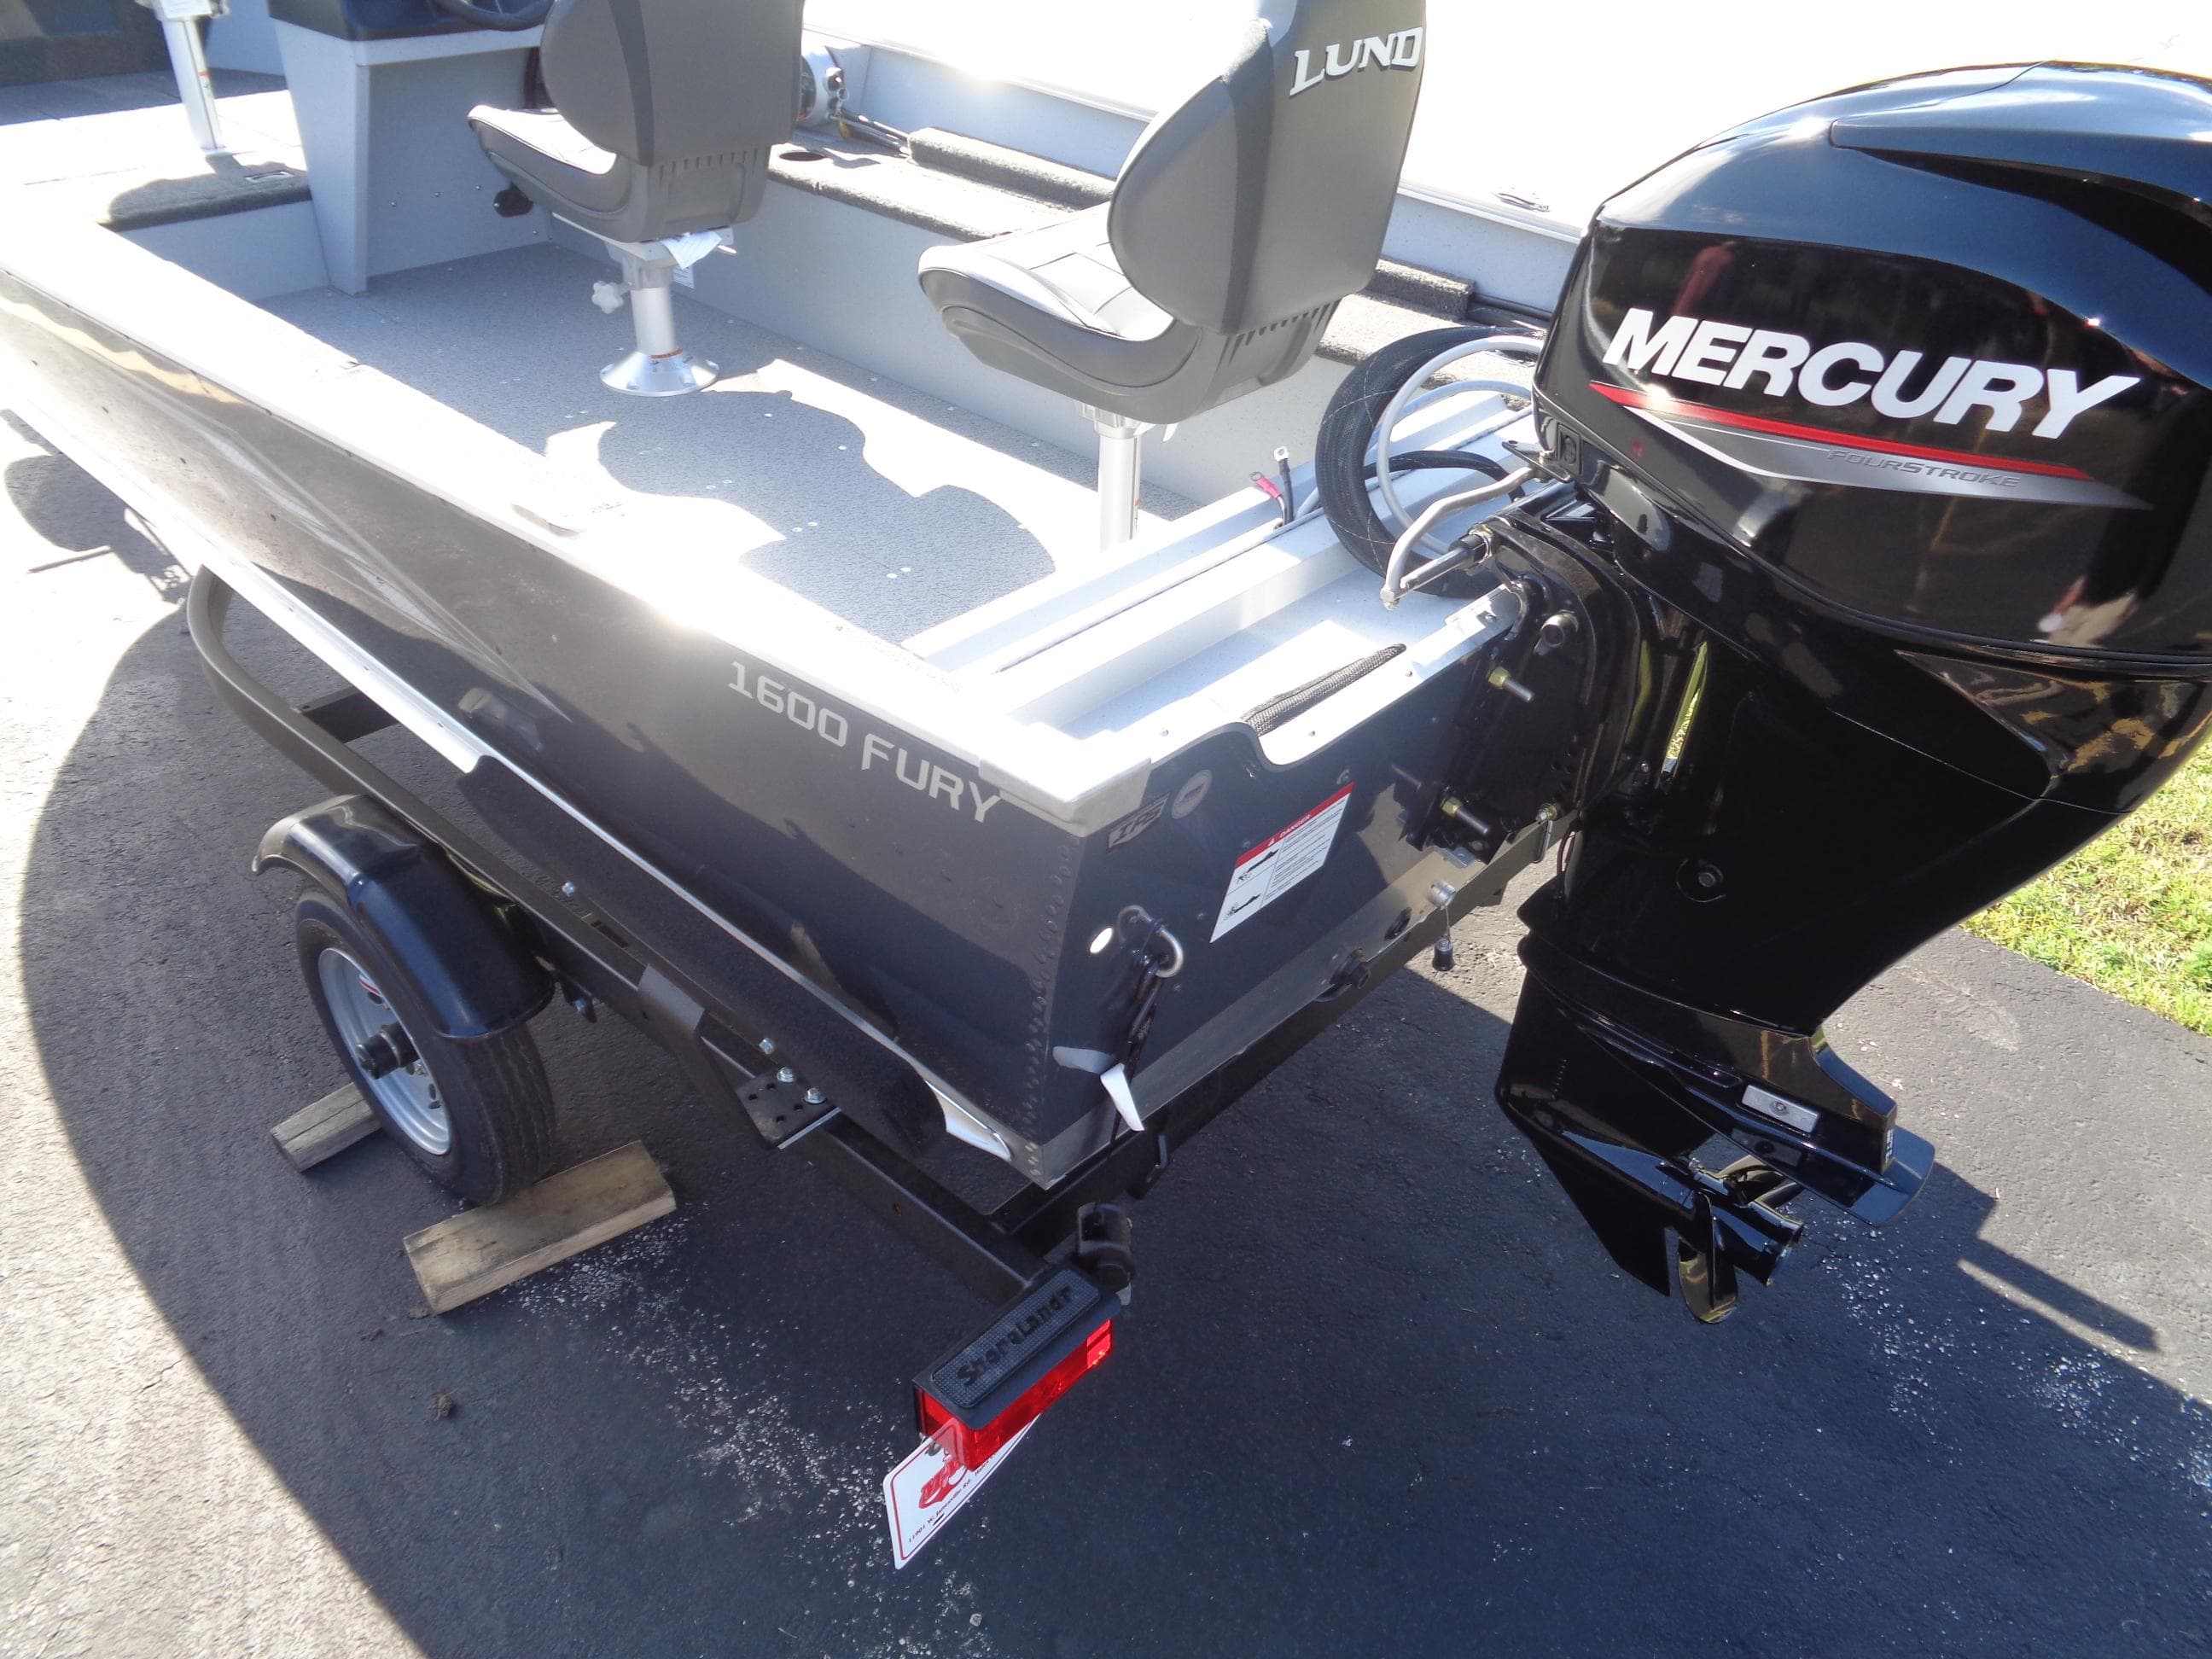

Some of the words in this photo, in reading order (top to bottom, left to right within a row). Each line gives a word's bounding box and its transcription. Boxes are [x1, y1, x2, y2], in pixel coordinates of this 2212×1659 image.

[1289, 26, 1423, 96] LUND
[1603, 307, 2140, 439] MERCURY
[1826, 450, 2022, 488] FOURSTROKE
[728, 661, 848, 748] 1600
[861, 732, 1002, 823] FURY
